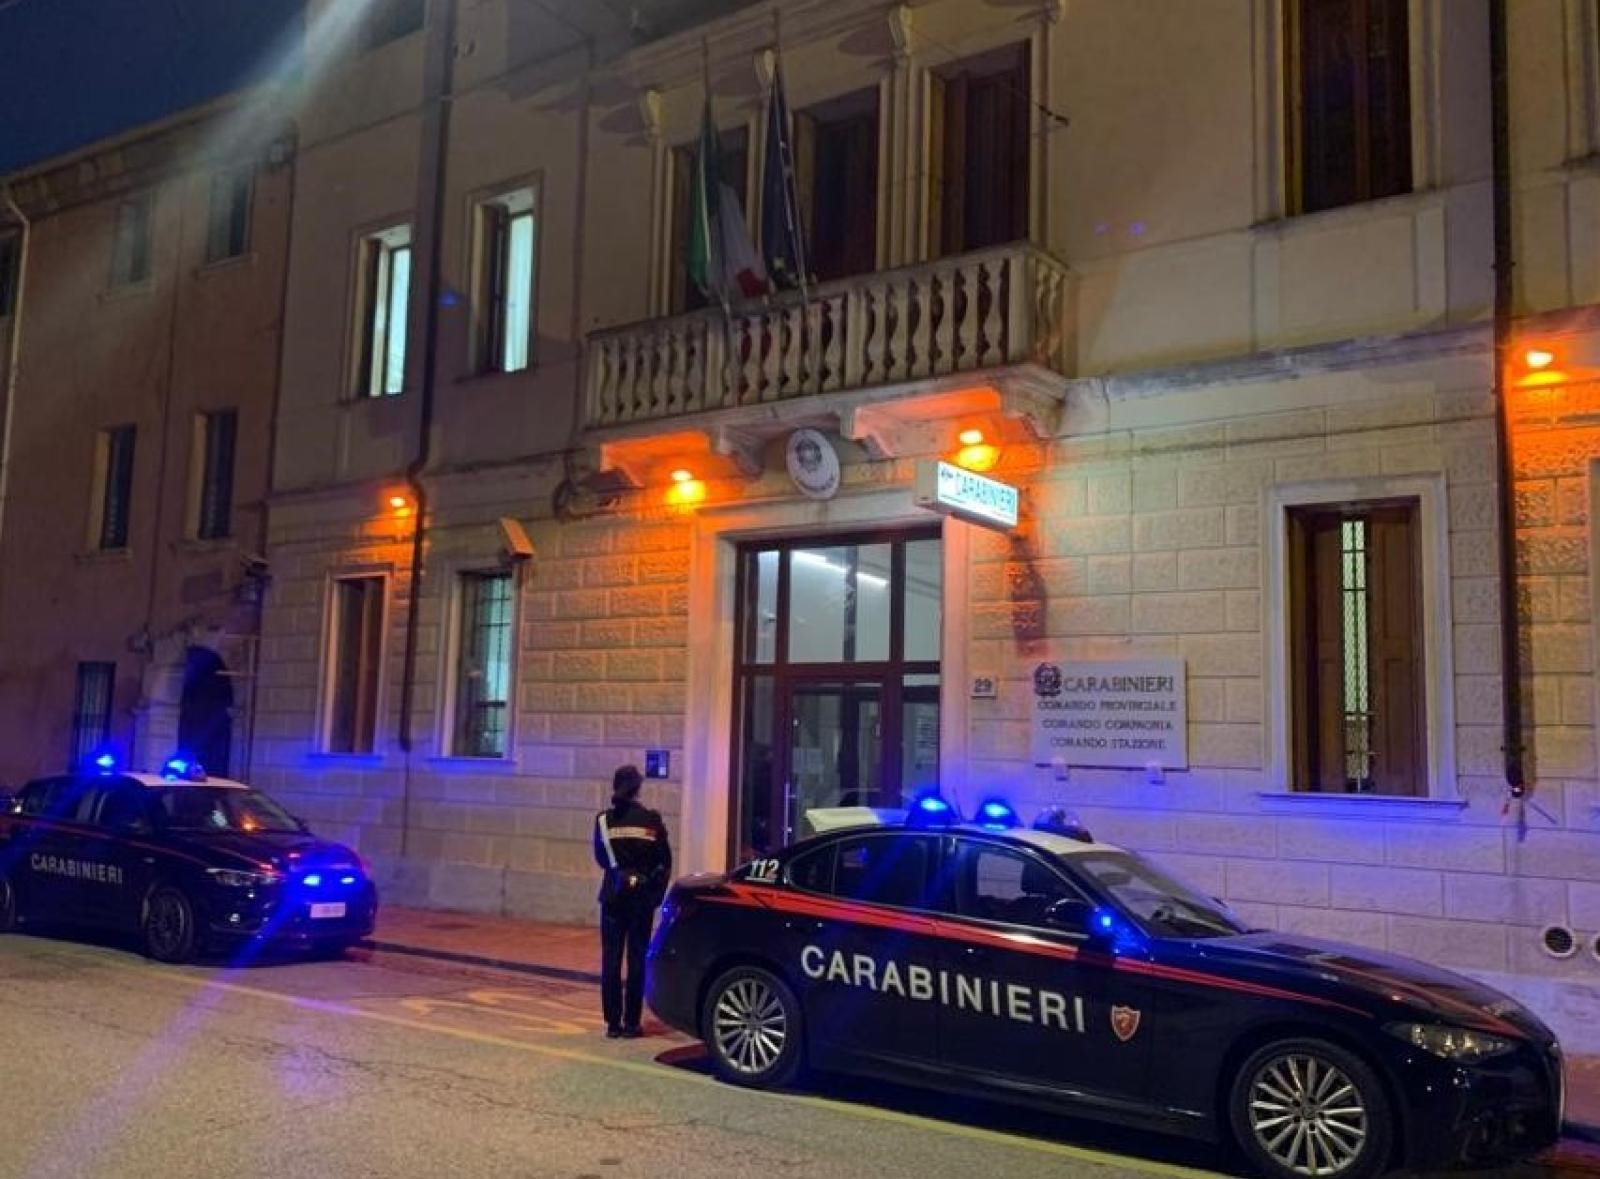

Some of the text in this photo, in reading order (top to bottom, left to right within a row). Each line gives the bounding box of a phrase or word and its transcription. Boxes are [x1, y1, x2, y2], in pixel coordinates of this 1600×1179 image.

[956, 471, 1015, 512] CARANERI
[975, 678, 992, 693] 29
[1063, 675, 1174, 693] CARABINIERI
[31, 852, 123, 884] CARABINIERI
[750, 858, 779, 879] 112
[801, 945, 1086, 1034] CARABINIERI
